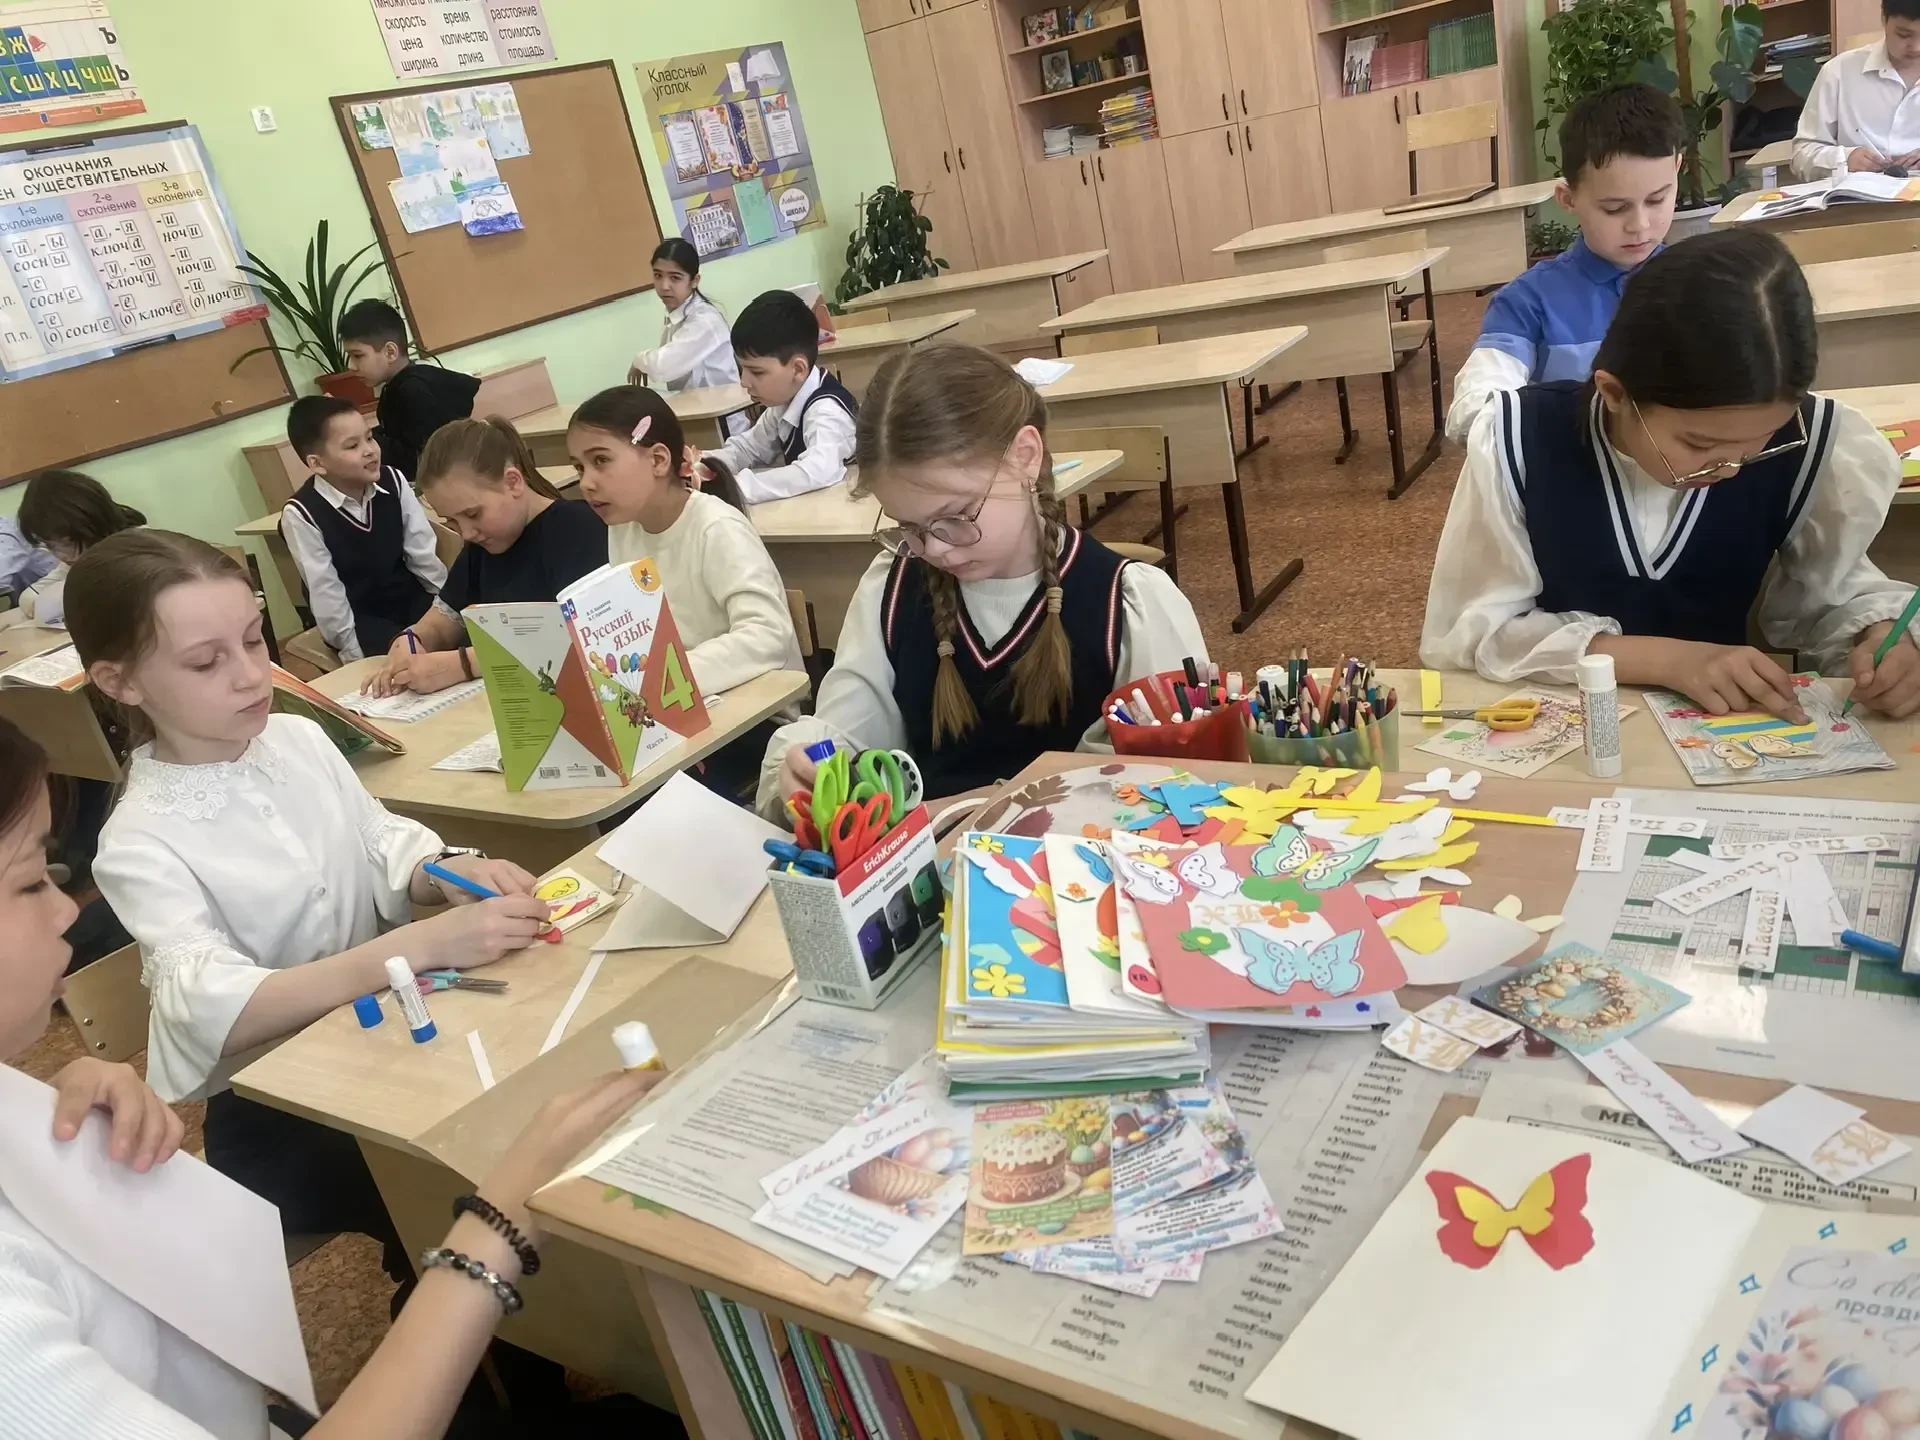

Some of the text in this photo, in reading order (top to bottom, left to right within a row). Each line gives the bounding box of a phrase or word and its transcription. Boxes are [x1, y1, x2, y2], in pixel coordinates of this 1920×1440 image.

[384, 5, 538, 32] скорость время расстояние
[7, 36, 28, 54] Ж
[99, 27, 117, 44] Ъ
[399, 26, 541, 52] цена количество стоимость
[401, 45, 545, 73] ширина длина площадь
[647, 62, 708, 84] Классный
[652, 81, 692, 100] уголок
[23, 156, 113, 181] ОКОНЧАНИЯ
[23, 161, 168, 197] СУЩЕСТВИТЕЛЬНЫХ
[147, 188, 203, 205] склонение
[162, 181, 180, 192] 3-е
[77, 199, 137, 218] склонение
[92, 193, 112, 204] 2-е
[0, 211, 64, 232] склонение
[17, 205, 38, 217] 1-е
[786, 206, 807, 217] ШКОЛА
[579, 608, 634, 648] Русский
[661, 641, 696, 713] 4
[863, 830, 909, 873] ErichKrause
[851, 834, 931, 907] MECHANICAL PENCIL SHARPENER
[1758, 1165, 1806, 1182] речи,
[1732, 1171, 1743, 1179] и
[1753, 1174, 1773, 1185] их
[1783, 1180, 1873, 1203] признаки
[1751, 1183, 1773, 1195] на
